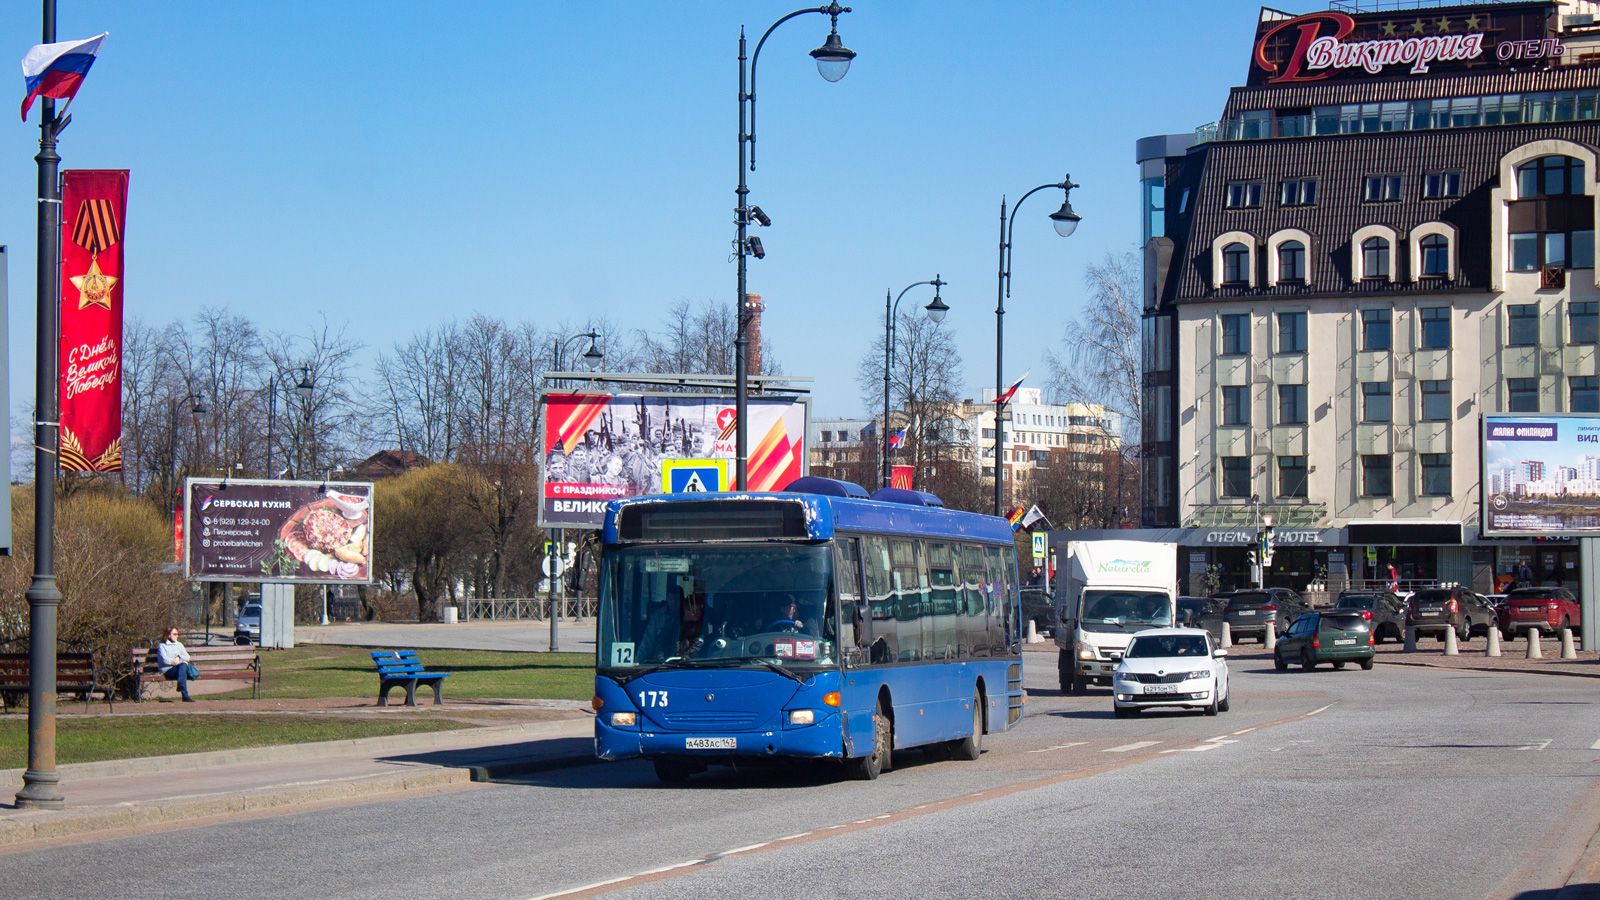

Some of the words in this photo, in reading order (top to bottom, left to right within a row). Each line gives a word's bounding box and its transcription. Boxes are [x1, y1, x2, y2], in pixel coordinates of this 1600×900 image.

[1307, 32, 1484, 75] Виктория
[1496, 38, 1566, 61] ОТЕЛЬ
[69, 347, 78, 363] С
[80, 335, 115, 361] Днём
[66, 347, 117, 383] Великой
[67, 361, 119, 399] Победы!
[1492, 427, 1514, 437] МАЛАЯ
[1516, 427, 1553, 438] ФИНЛЯНДИЯ
[1577, 434, 1598, 443] ВИД
[553, 486, 561, 494] С
[562, 486, 626, 496] ПРАЗДНИКОМ
[213, 499, 260, 508] СЕРБСКАЯ
[262, 500, 291, 509] КУХНЯ
[220, 517, 235, 526] (929)
[237, 518, 271, 526] 129-24-00
[1206, 531, 1251, 543] ОТЕЛЬ
[1278, 531, 1323, 543] HOTEL
[616, 647, 632, 664] 12
[638, 690, 668, 708] 173
